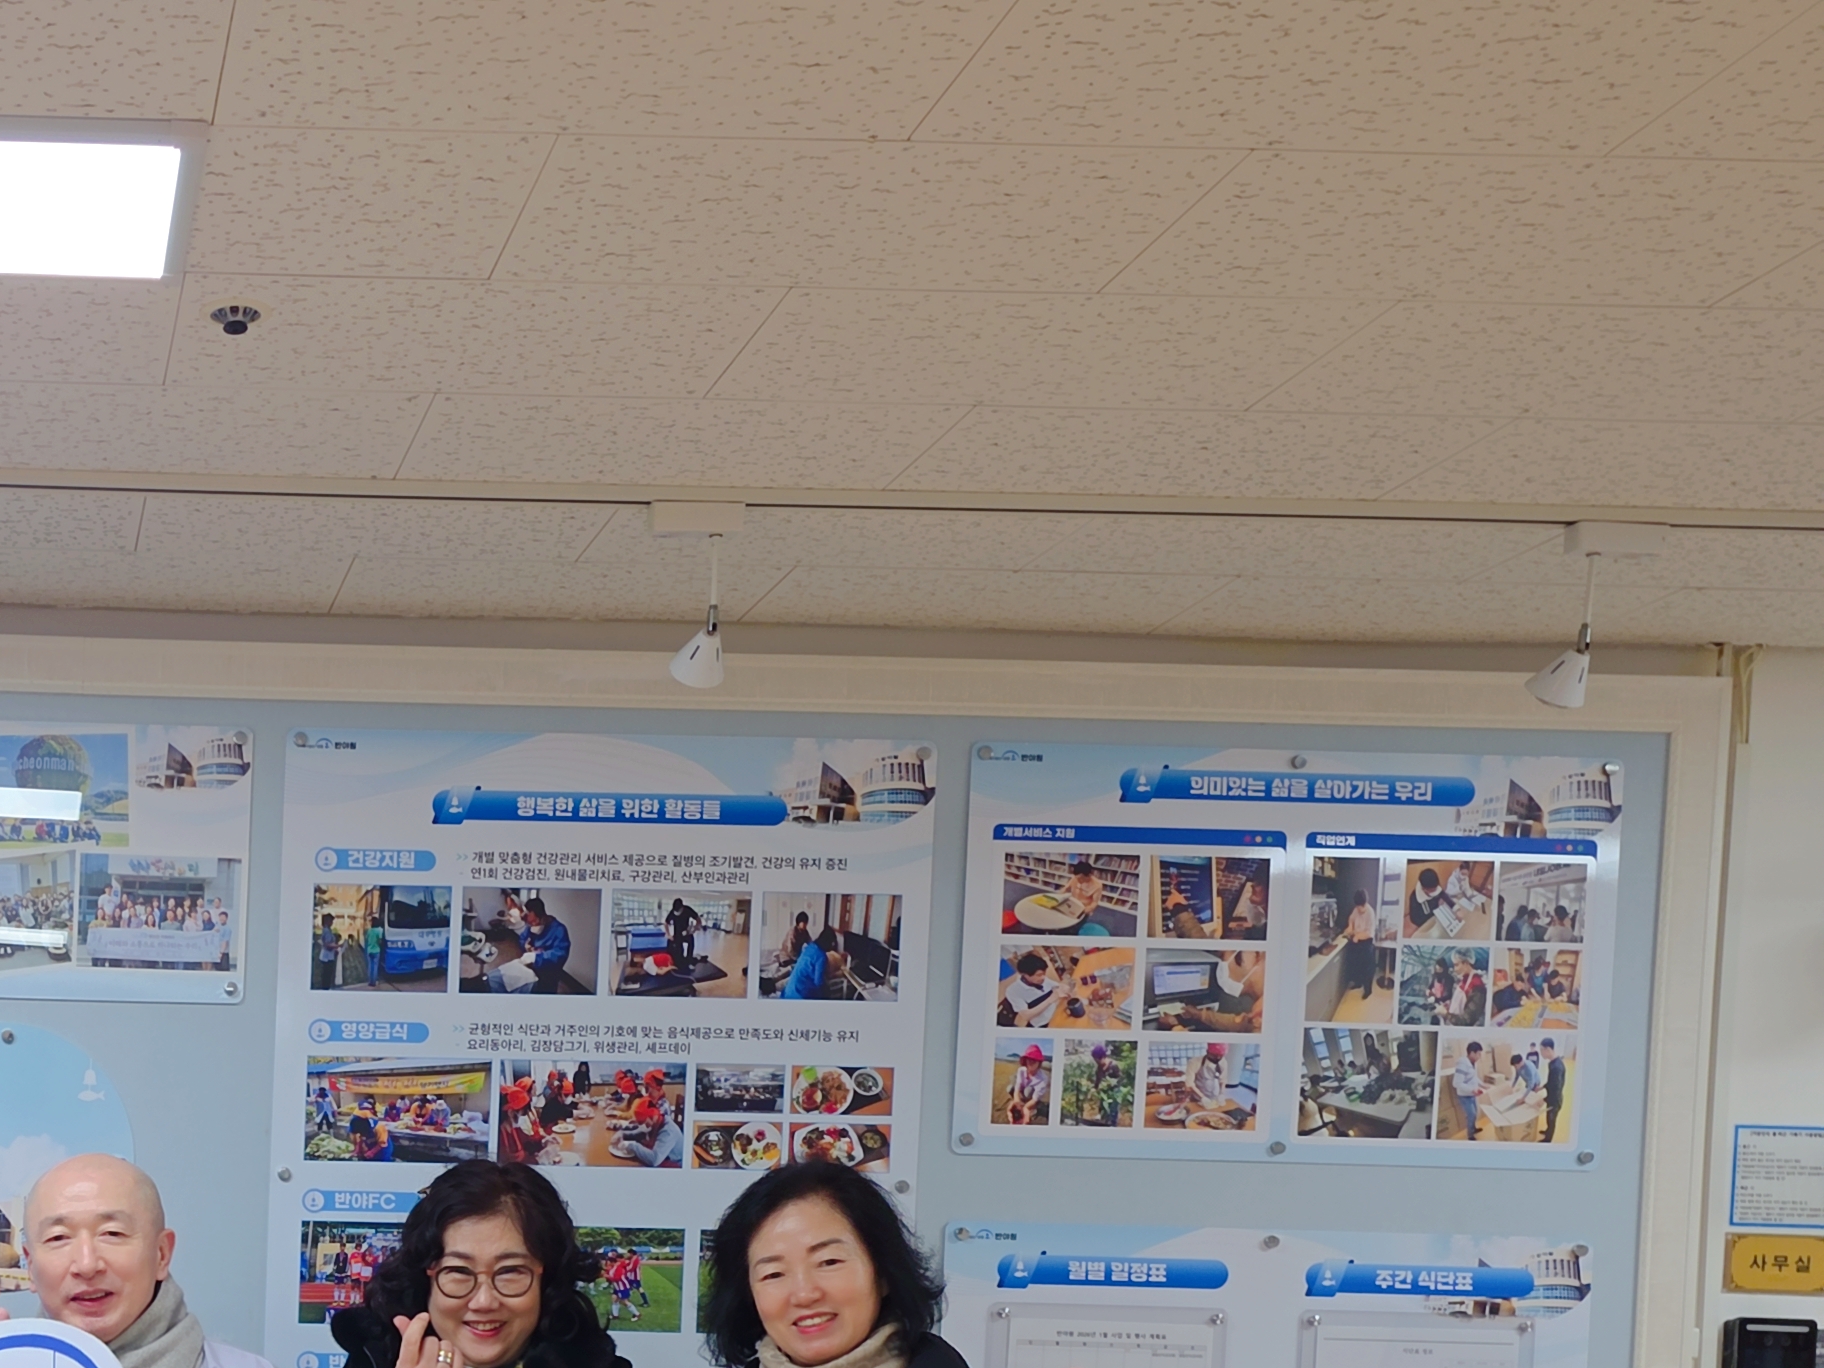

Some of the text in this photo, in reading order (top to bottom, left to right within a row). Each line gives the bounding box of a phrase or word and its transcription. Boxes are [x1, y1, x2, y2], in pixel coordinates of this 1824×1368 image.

[1190, 776, 1432, 802] 의미있는 삶을 살아가는 우리
[517, 796, 720, 820] 행복한 삶을 위한 활동들
[347, 850, 415, 869] 건강지원
[472, 851, 495, 863] 개별
[498, 851, 533, 865] 맞춤형
[536, 852, 582, 866] 건강관리
[584, 853, 619, 866] 서비스
[622, 853, 668, 867] 제공으로
[671, 854, 706, 868] 질병의
[761, 857, 796, 869] 건강의
[799, 858, 822, 870] 유지
[825, 858, 848, 870] 증진
[341, 1022, 408, 1040] 영양급식
[468, 1023, 860, 1042] 균형적인 식단과 거주인의 기호에 맞는 음식제공으로 만족도와 신체기능 유지
[335, 1192, 396, 1210] 반야FC
[1067, 1260, 1167, 1283] 월별 일정표
[1749, 1253, 1812, 1273] 사무실
[1375, 1269, 1474, 1291] 주간 식단표
